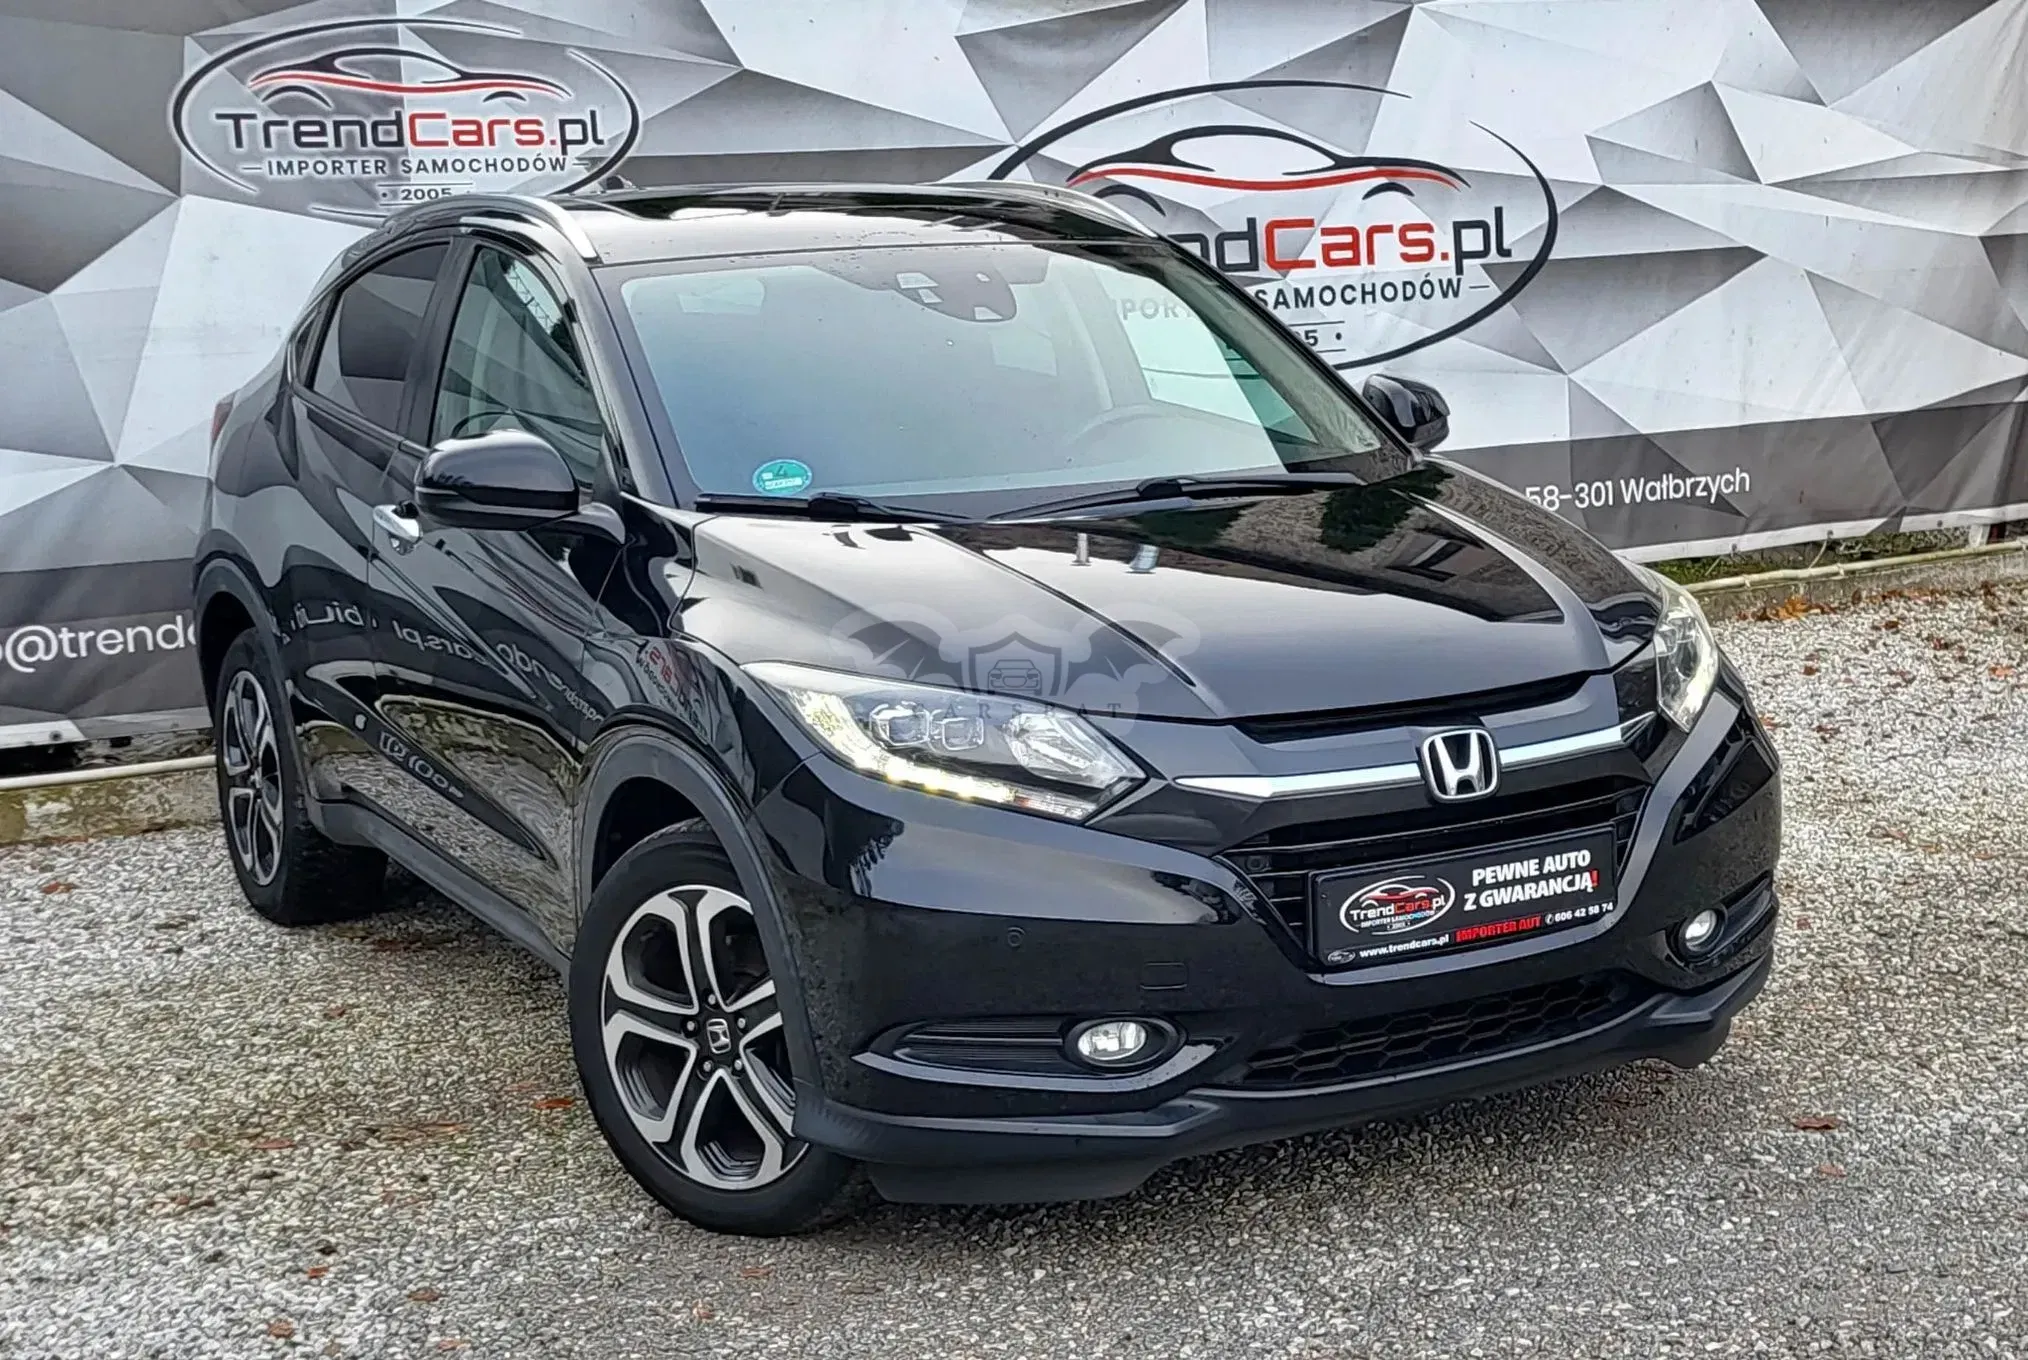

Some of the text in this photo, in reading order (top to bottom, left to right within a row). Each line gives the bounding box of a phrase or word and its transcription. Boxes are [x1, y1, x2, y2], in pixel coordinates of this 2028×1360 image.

[215, 110, 604, 156] TrendCars.pl
[267, 154, 567, 176] IMPORTER SAMOCHODÓW
[1255, 272, 1462, 310] SAMOCHODÓW
[1525, 467, 1750, 512] 58-301 Wałbrzych
[0, 615, 196, 673] @trend
[1472, 849, 1591, 887] PEWNE AUTO
[1349, 895, 1446, 921] TrendCars.pl
[1463, 869, 1599, 911] Z GWARANCJĄ!
[1455, 915, 1542, 942] IMPORTER AUT
[1574, 907, 1587, 917] 42
[1601, 902, 1613, 912] 74
[1359, 934, 1449, 958] www.trendcars.pl
